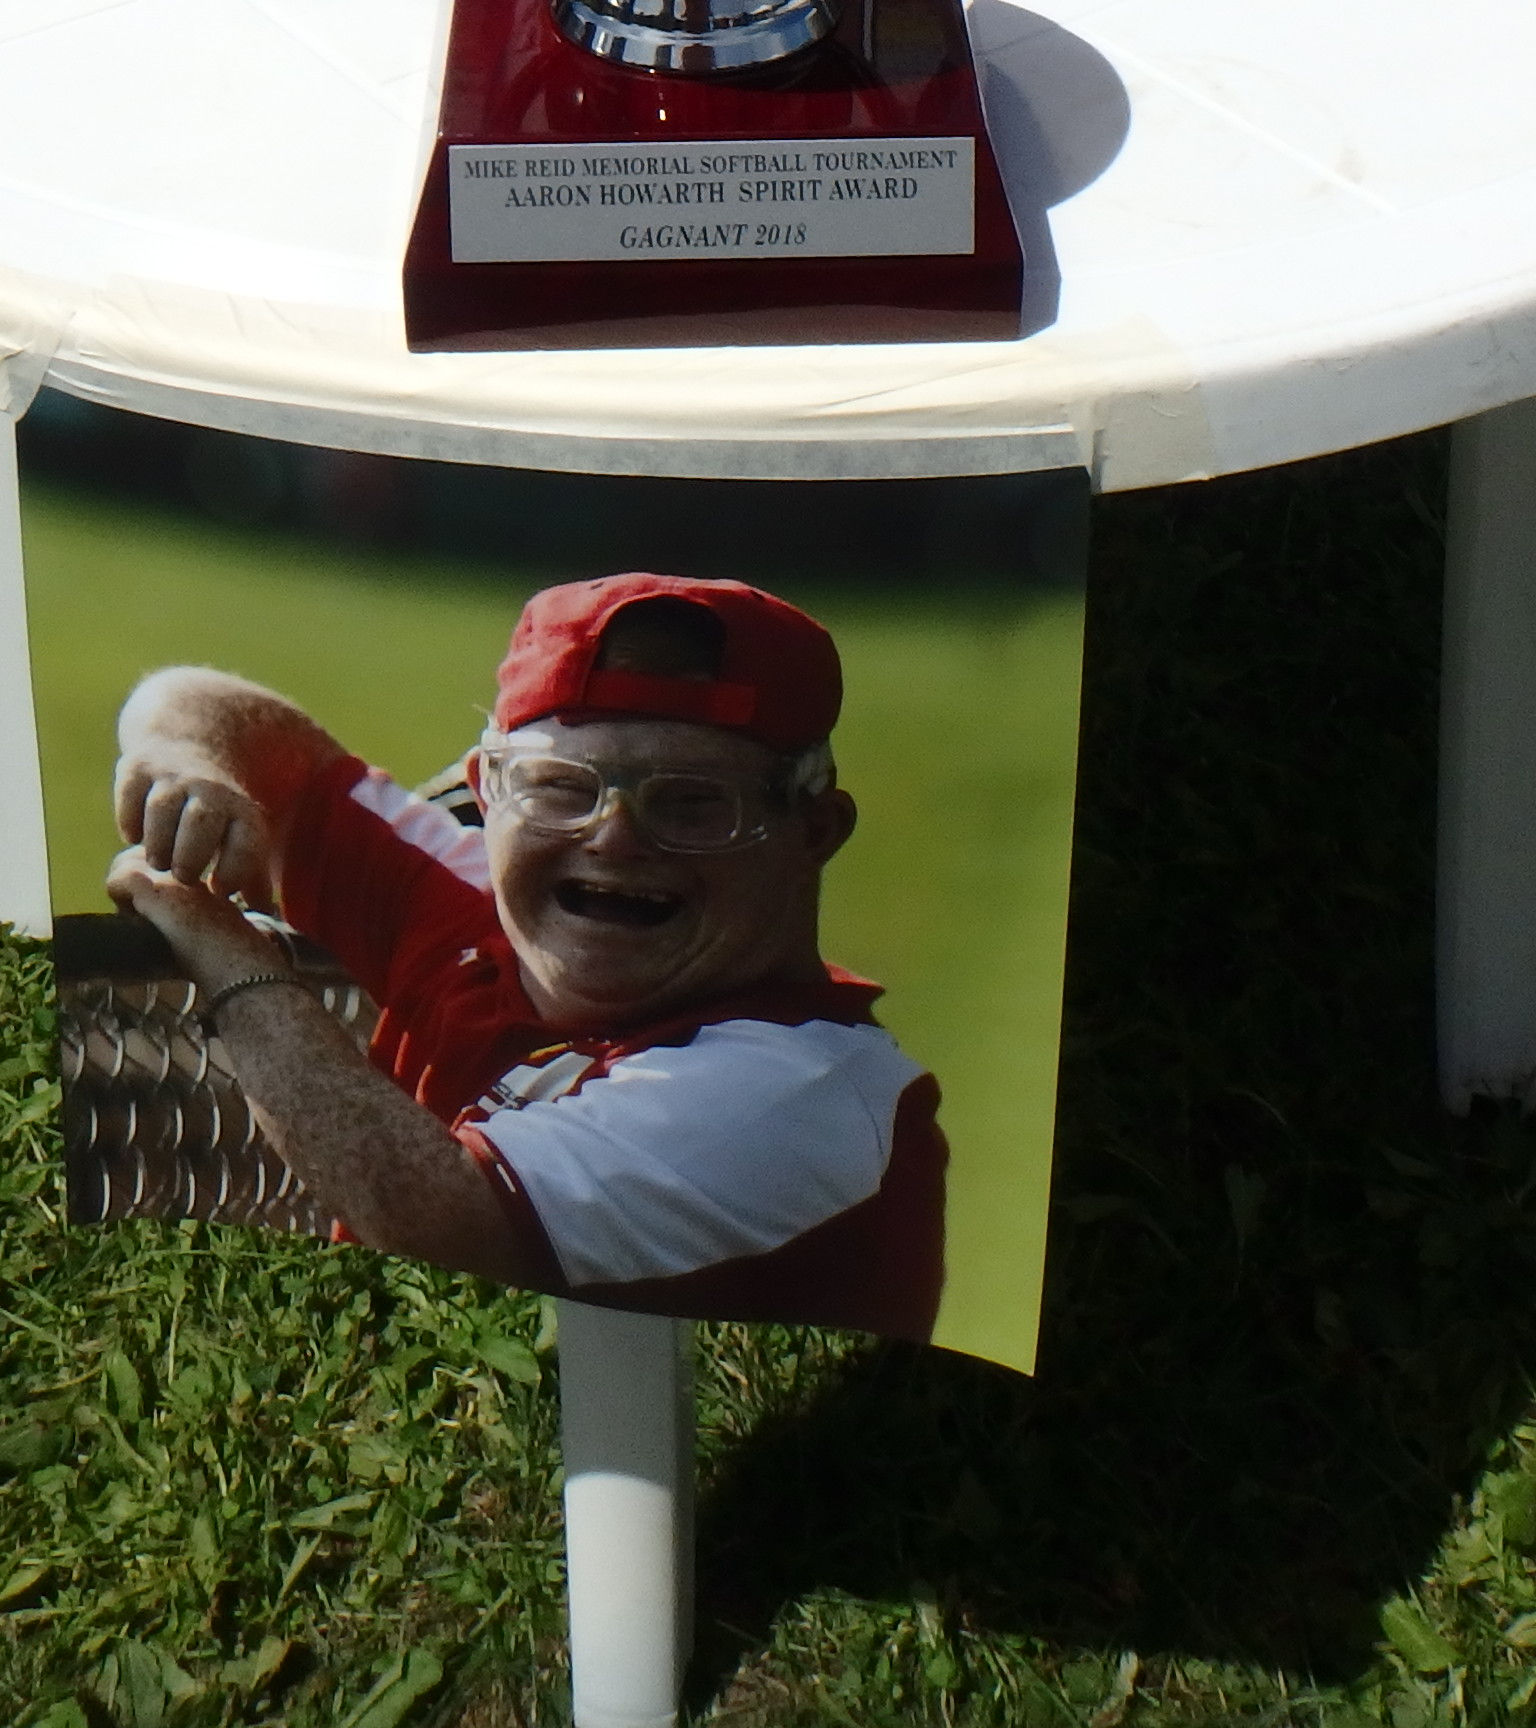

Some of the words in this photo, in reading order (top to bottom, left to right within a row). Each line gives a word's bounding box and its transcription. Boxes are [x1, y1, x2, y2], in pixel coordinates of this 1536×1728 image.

[464, 159, 519, 179] MIKE
[524, 158, 576, 178] REID
[582, 155, 696, 177] MEMORIAL
[699, 153, 808, 175] SOFTBALL
[811, 149, 958, 173] TOURNAMENT
[504, 184, 591, 208] AARON
[599, 181, 725, 207] HOWARTH
[738, 178, 823, 204] SPIRIT
[828, 177, 919, 202] AWARD
[619, 223, 749, 250] GAGNANT
[753, 221, 807, 247] 2018
